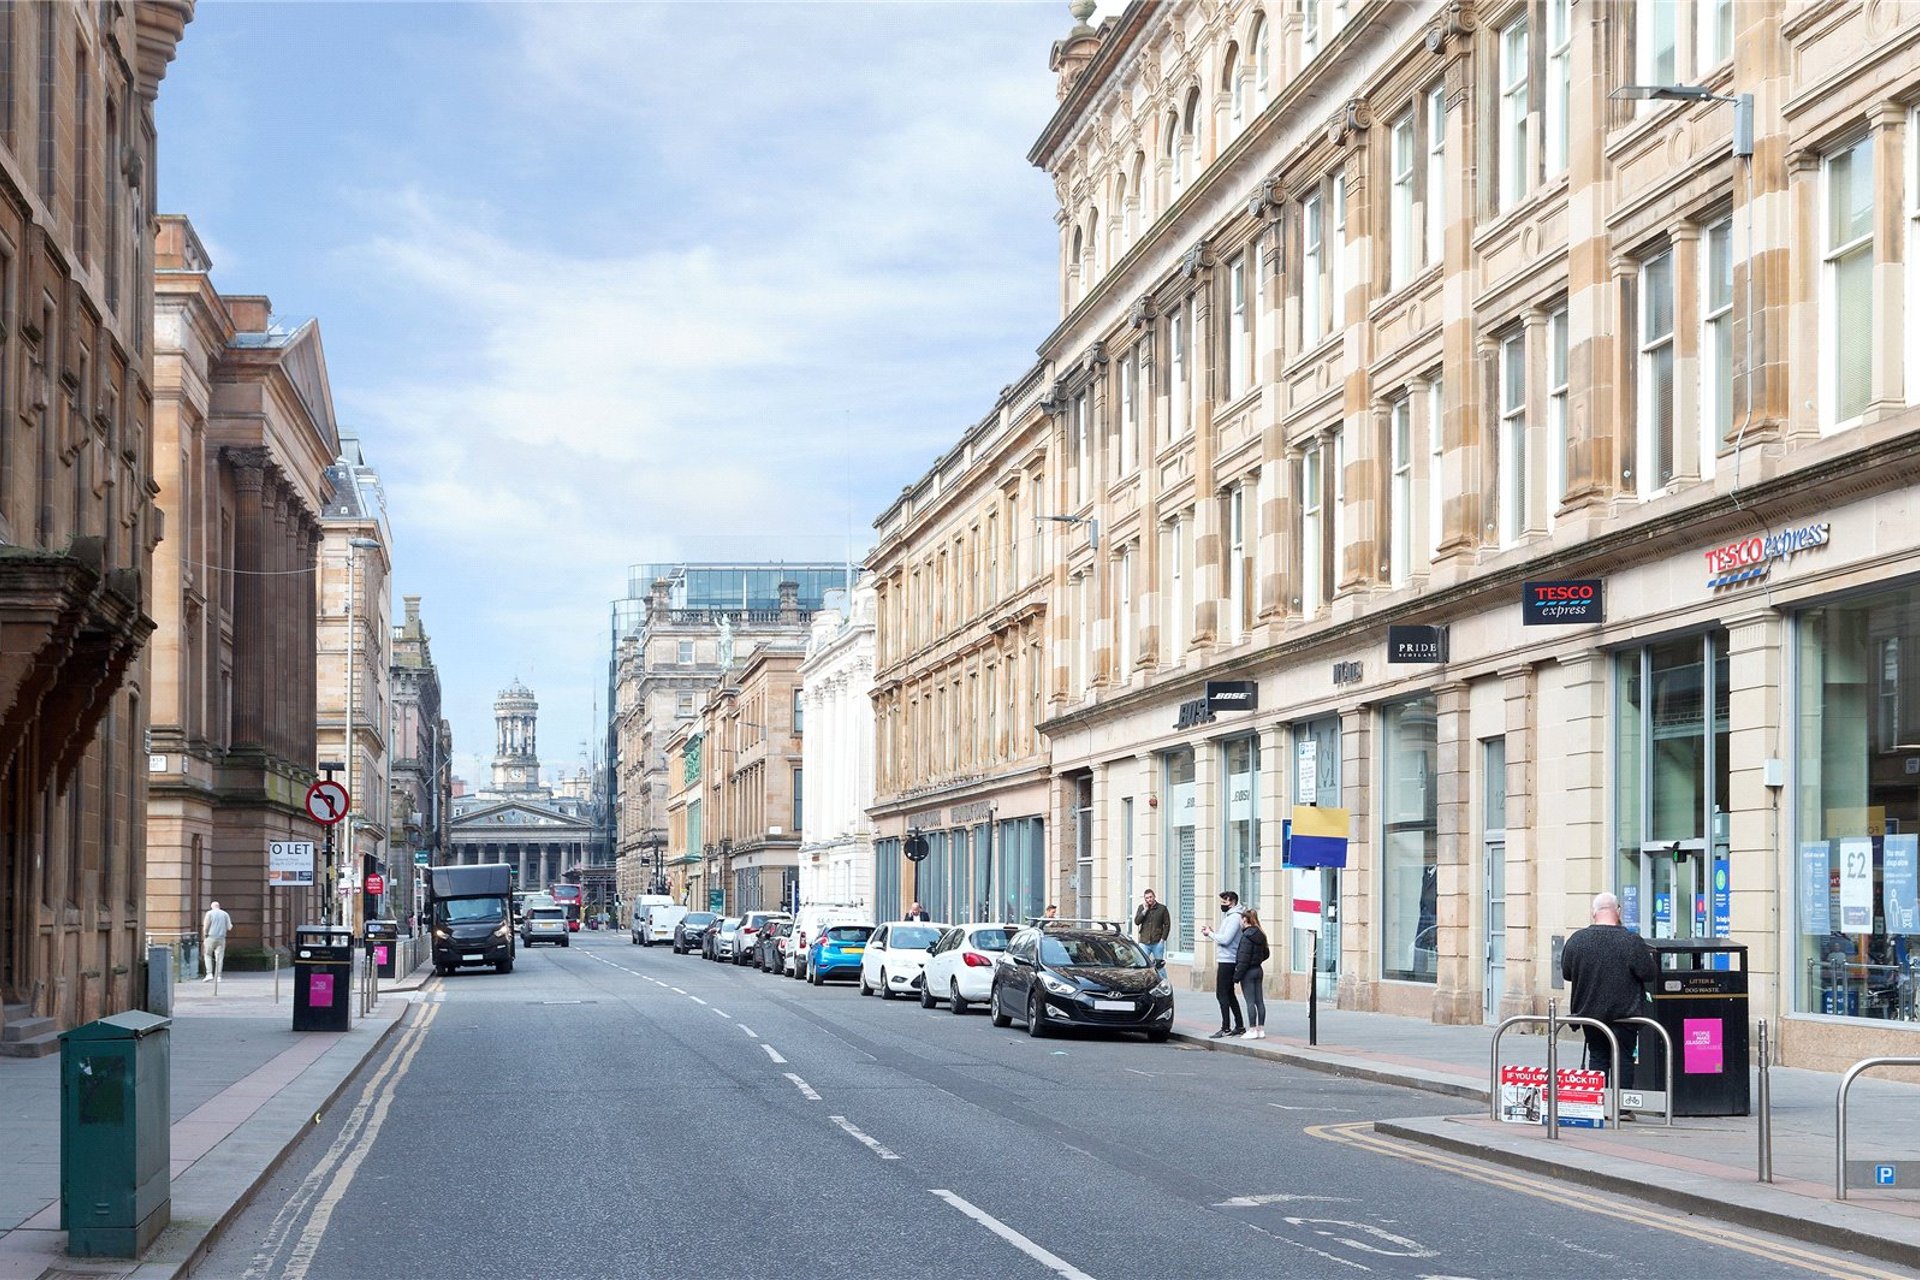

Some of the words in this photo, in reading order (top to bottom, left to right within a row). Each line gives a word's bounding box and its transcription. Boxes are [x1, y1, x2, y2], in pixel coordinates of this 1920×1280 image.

[1705, 537, 1763, 573] TESCO
[1763, 523, 1824, 557] express
[1534, 585, 1593, 600] TESCO
[1541, 605, 1586, 618] express
[1399, 643, 1437, 652] PRIDE
[1210, 692, 1252, 700] BOSE
[270, 843, 283, 855] O
[287, 843, 310, 855] LET
[1847, 852, 1866, 878] £2
[1515, 1072, 1531, 1080] YOU
[1565, 1074, 1588, 1084] LOCK
[1880, 1167, 1892, 1183] P
